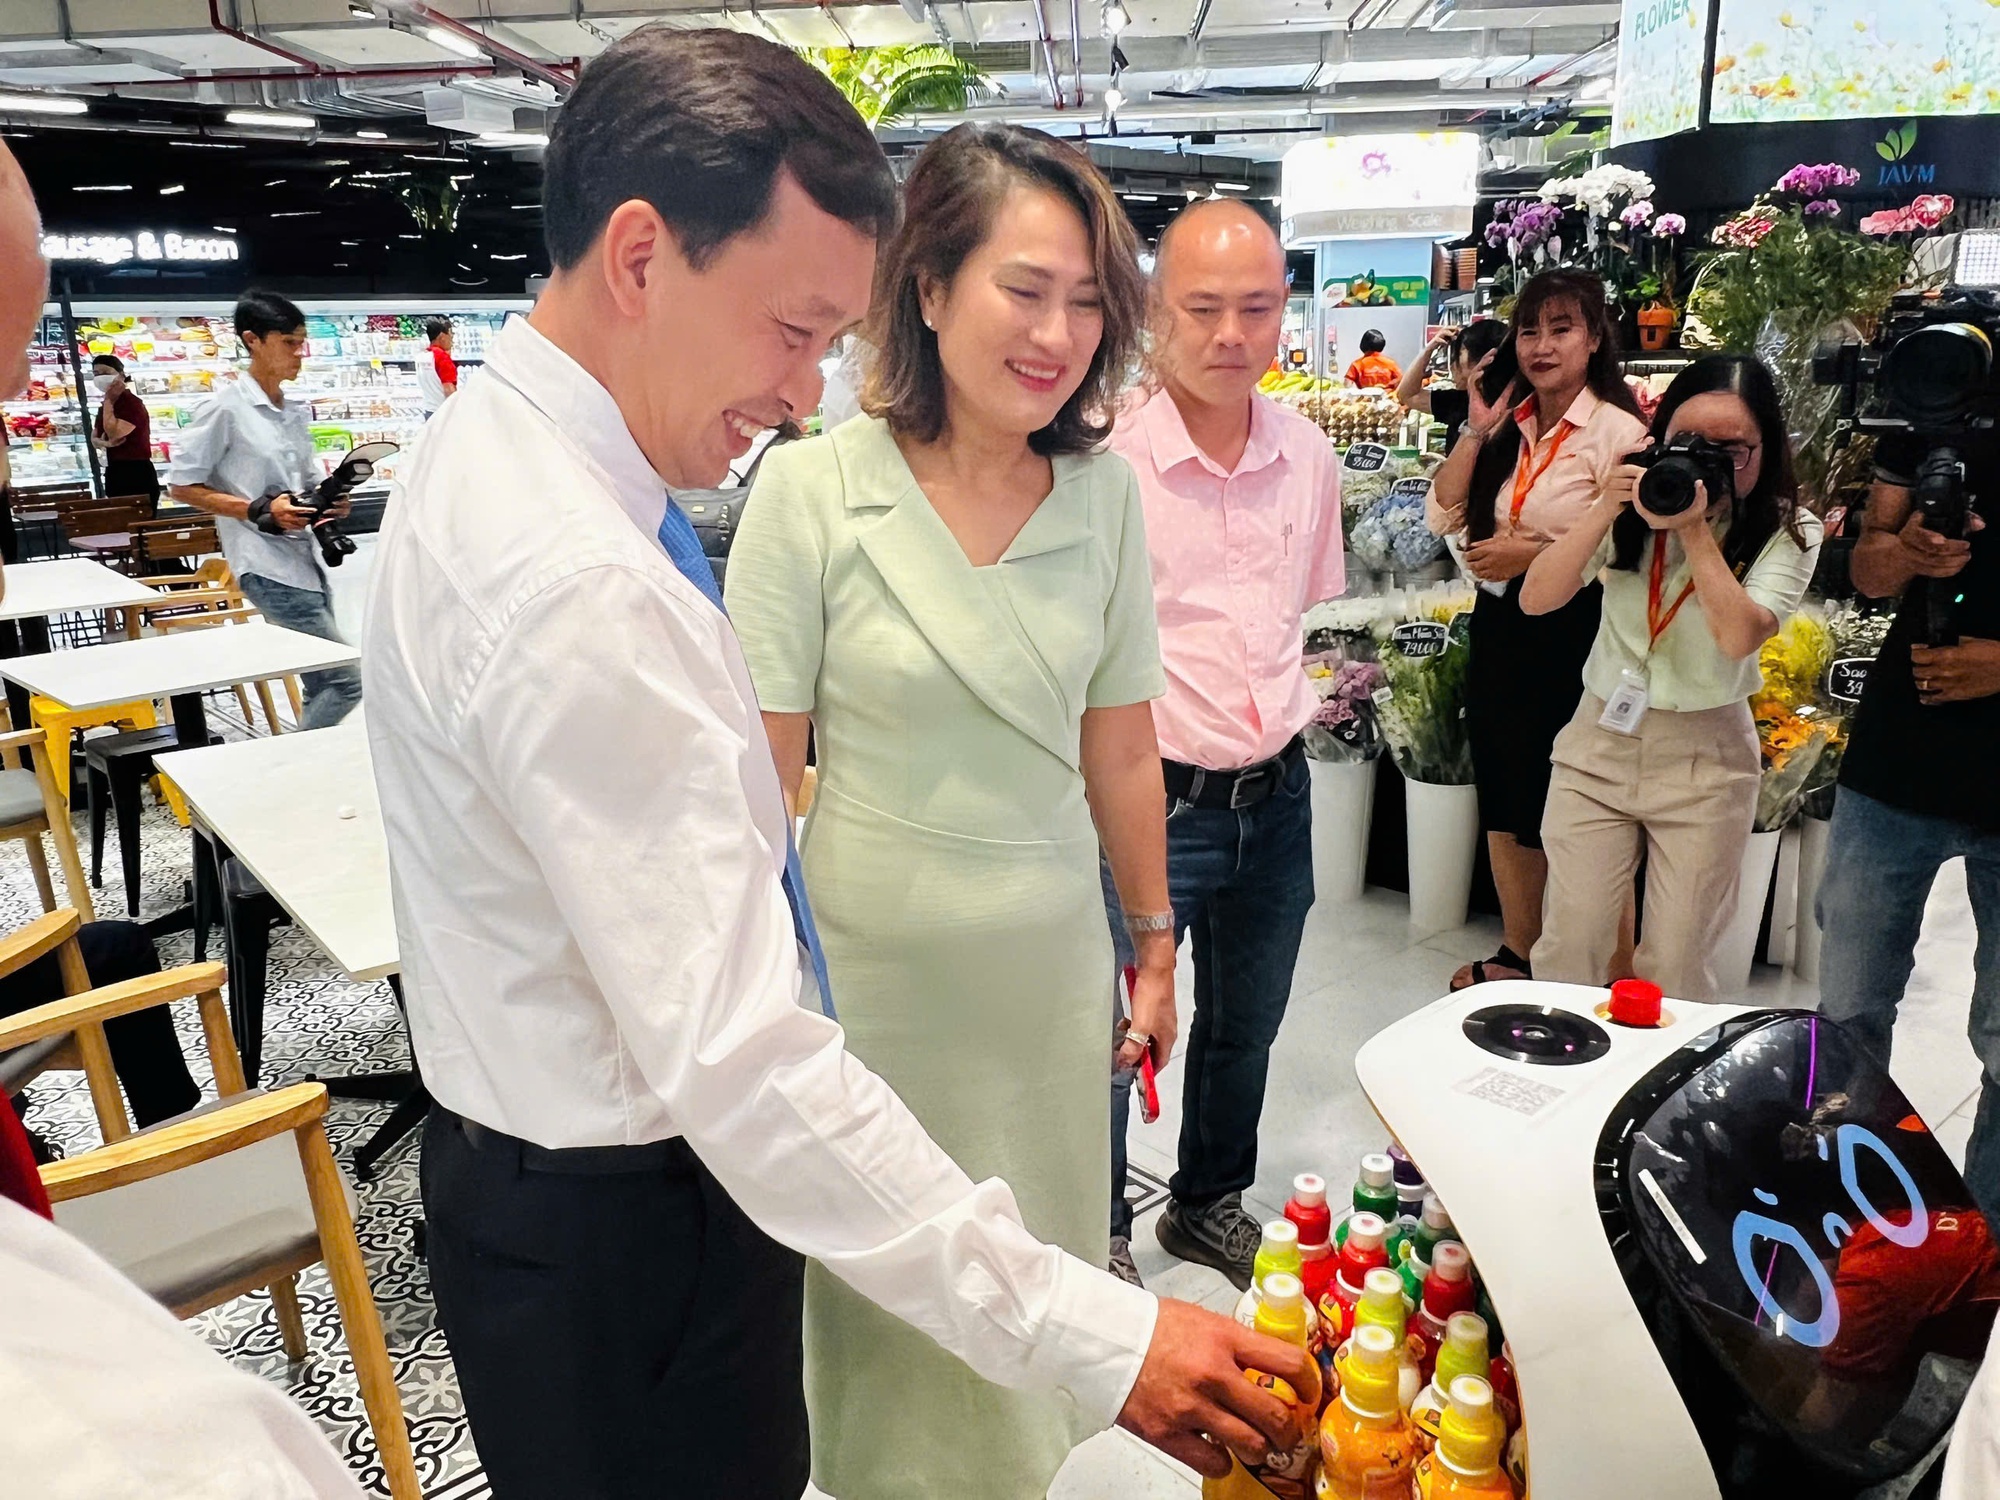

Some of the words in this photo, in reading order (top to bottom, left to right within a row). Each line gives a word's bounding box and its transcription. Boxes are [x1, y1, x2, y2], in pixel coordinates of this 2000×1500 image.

[1337, 214, 1399, 232] Weighing
[1407, 211, 1443, 228] Scale
[39, 231, 134, 264] ausage
[137, 231, 163, 259] &
[164, 233, 239, 260] Bacon
